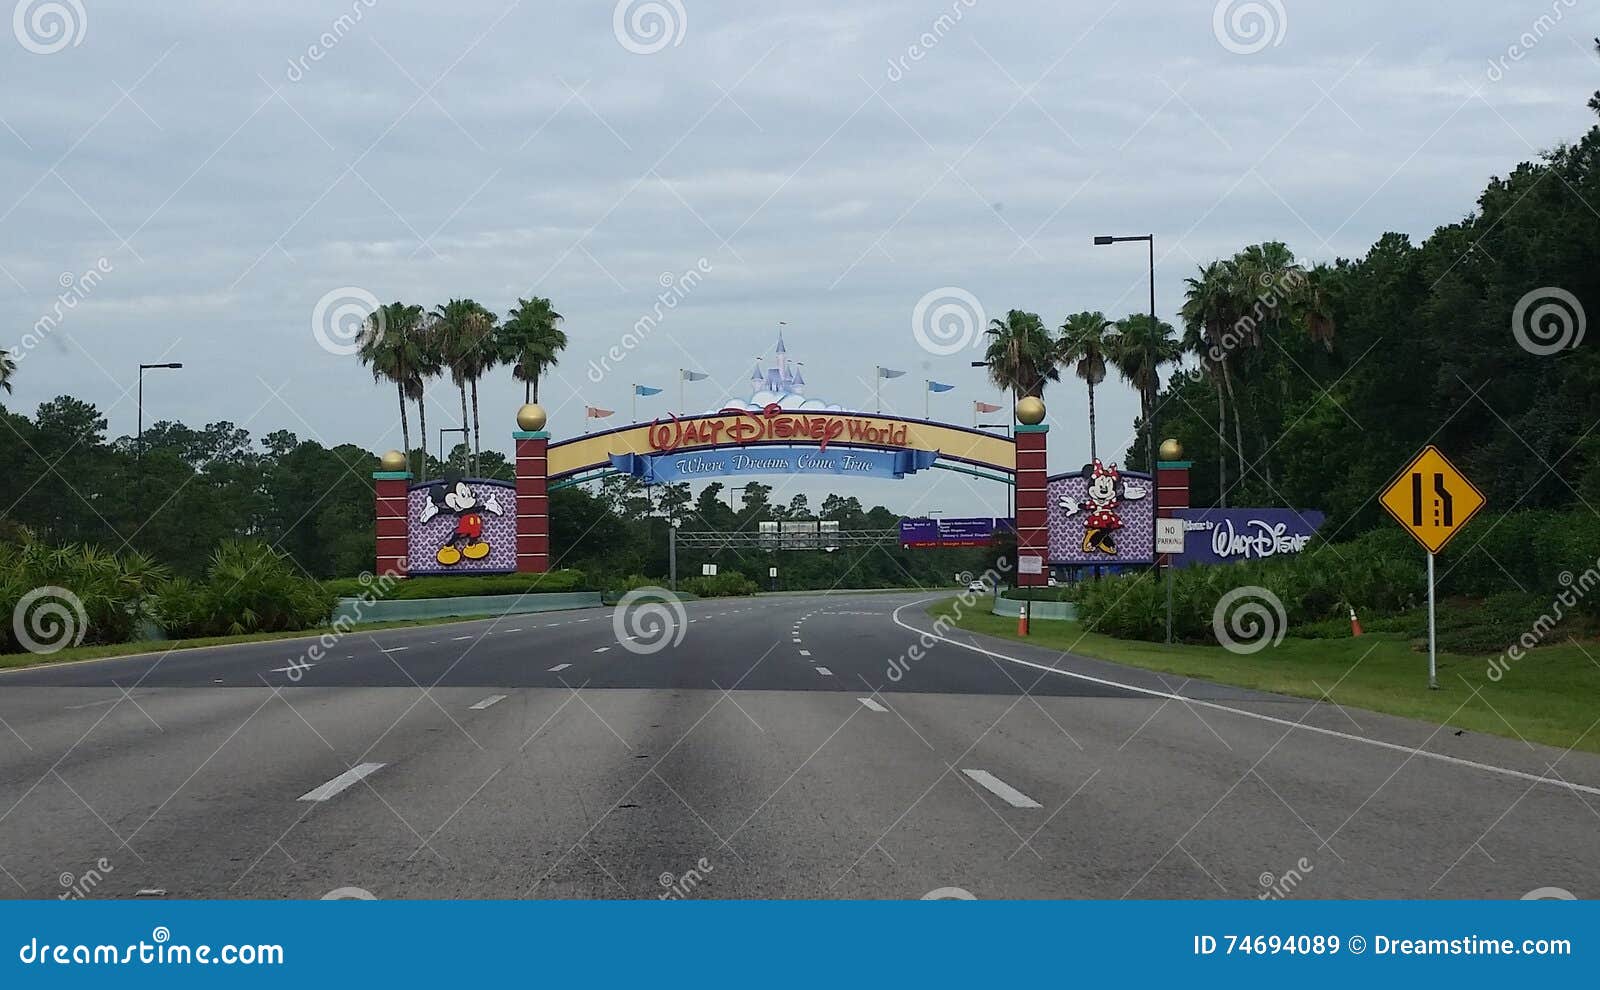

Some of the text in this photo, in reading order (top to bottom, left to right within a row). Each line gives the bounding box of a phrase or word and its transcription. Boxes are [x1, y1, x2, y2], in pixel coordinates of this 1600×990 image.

[845, 418, 907, 446] World
[676, 454, 873, 474] Where Dreams Come True
[1165, 526, 1175, 534] NO
[1248, 519, 1311, 558] DISNE
